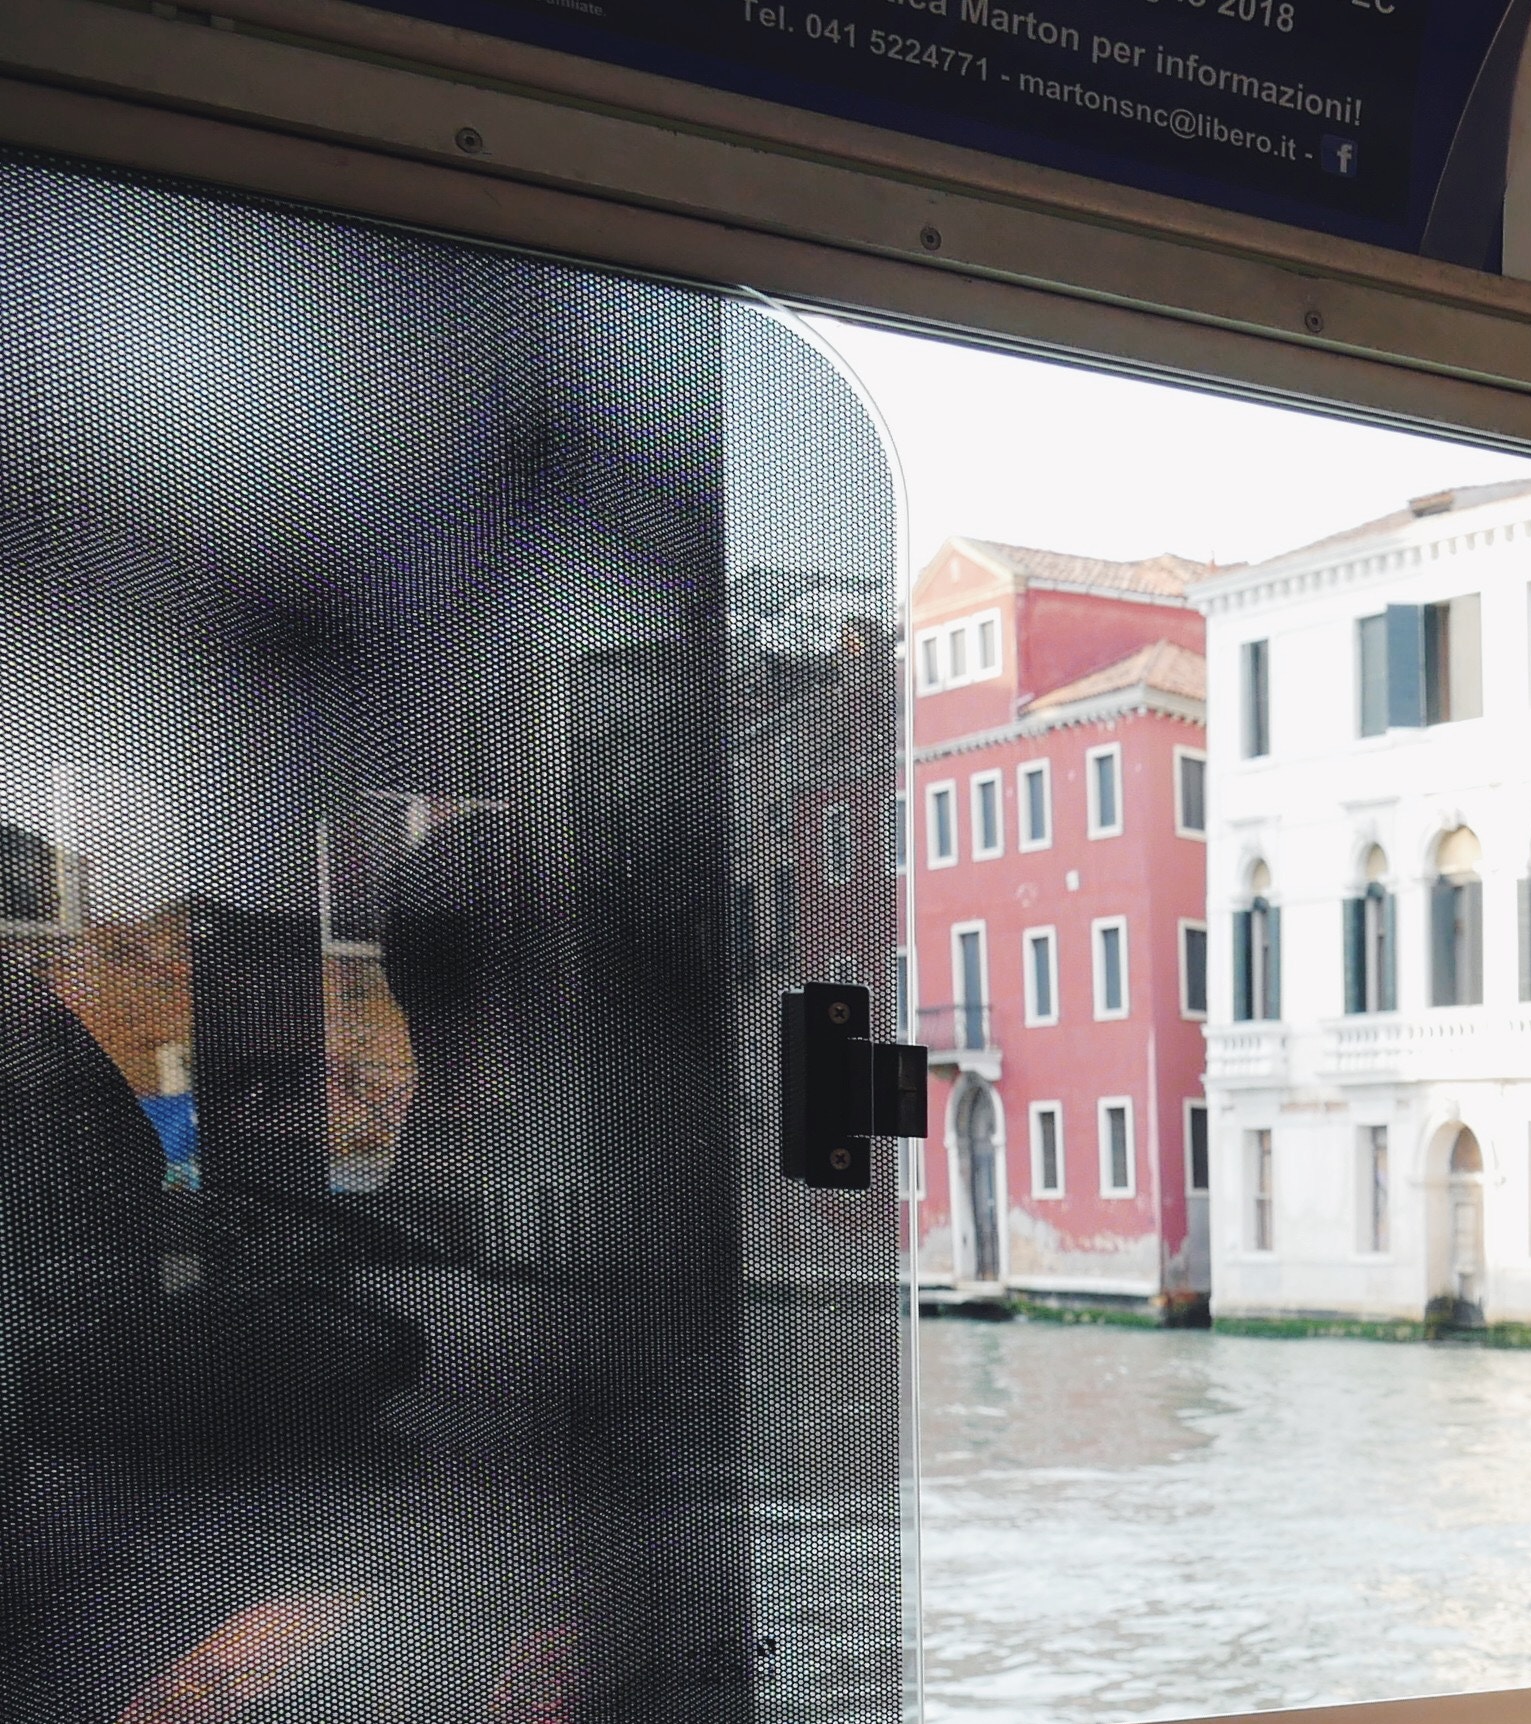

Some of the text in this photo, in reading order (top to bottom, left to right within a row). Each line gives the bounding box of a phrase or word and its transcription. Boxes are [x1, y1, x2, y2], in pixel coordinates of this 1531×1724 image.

[743, 0, 794, 33] Tel.
[806, 13, 857, 48] 041
[870, 29, 988, 81] 5224771
[1019, 71, 1297, 160] martonsnc@libero.it
[960, 0, 1362, 126] Marton per informazioni!
